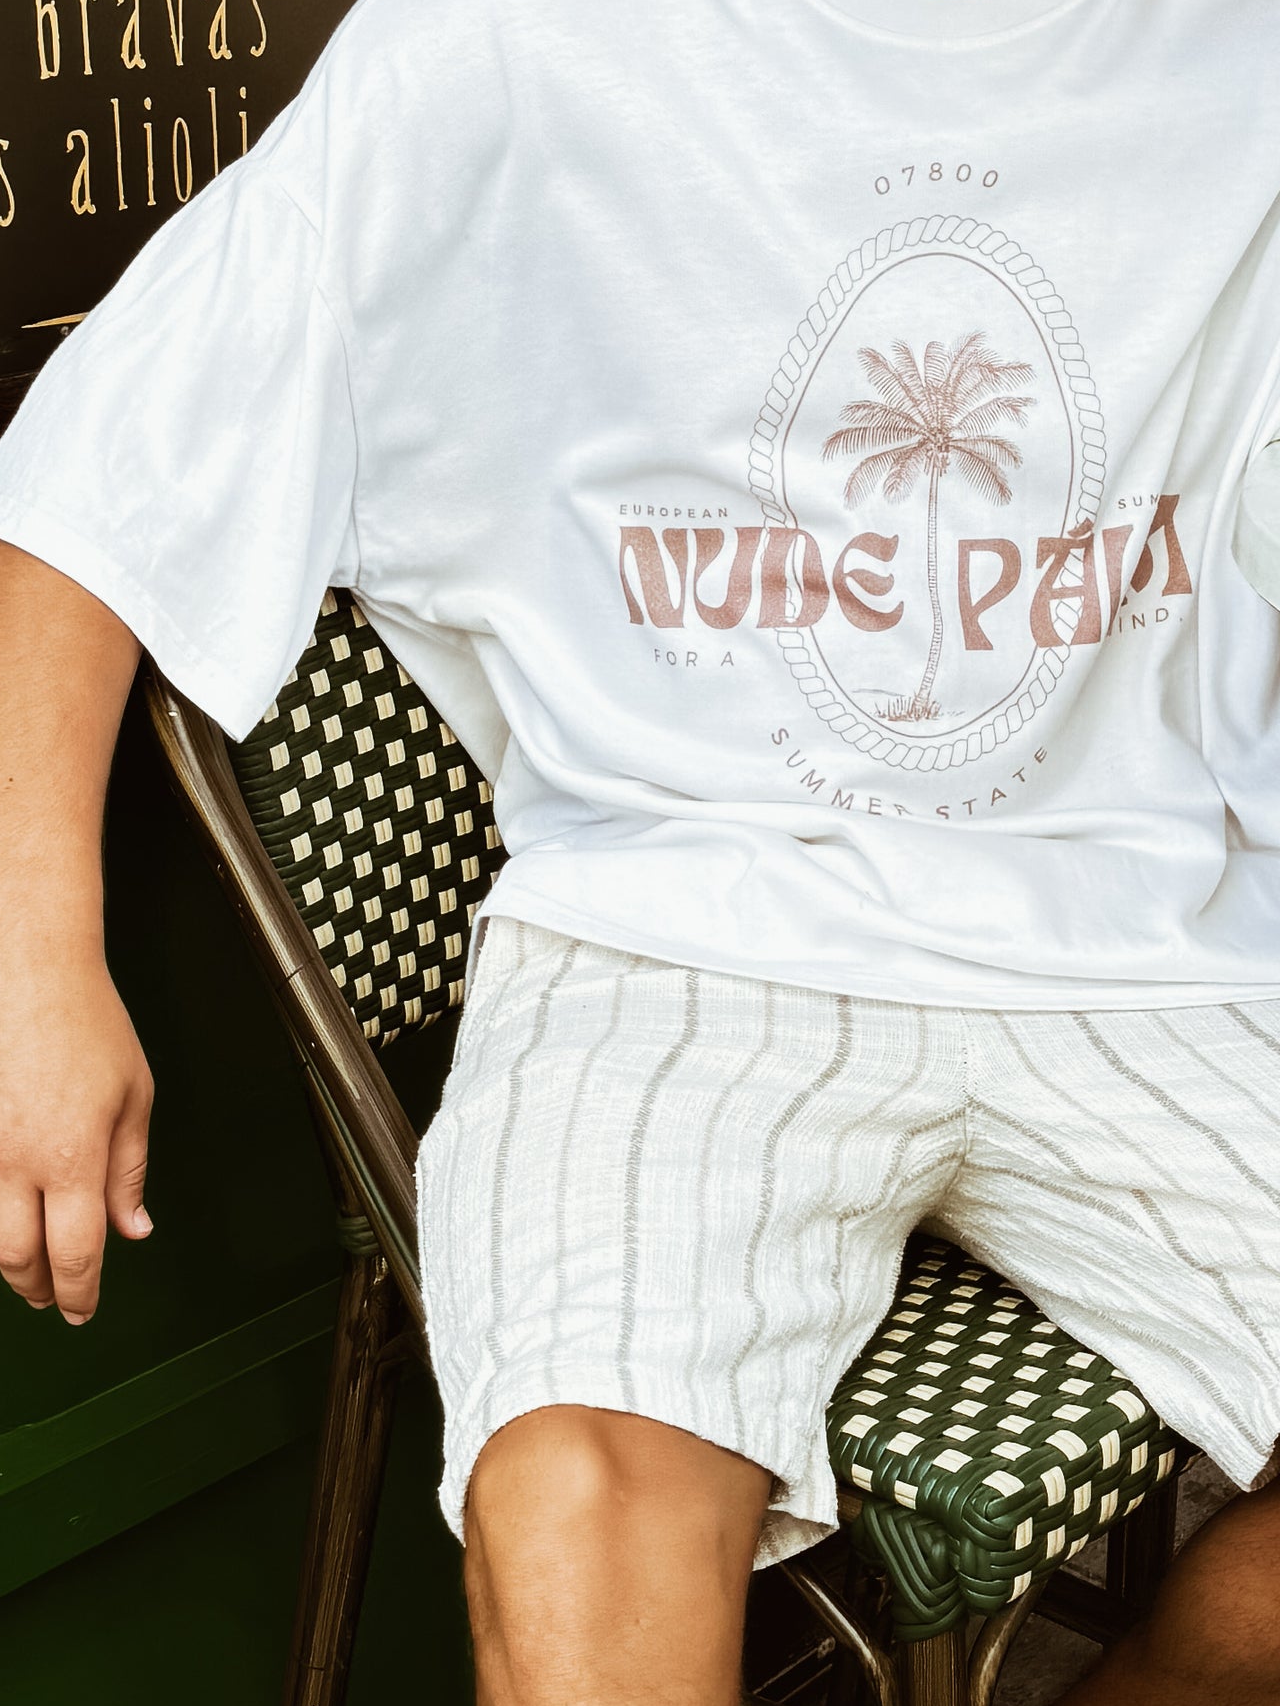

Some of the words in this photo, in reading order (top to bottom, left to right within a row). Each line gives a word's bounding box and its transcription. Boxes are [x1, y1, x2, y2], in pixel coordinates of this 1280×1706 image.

[873, 160, 1001, 196] 07800
[619, 503, 730, 519] EUROPEAN
[619, 526, 905, 633] NUDE
[654, 647, 698, 668] FOR
[720, 650, 735, 667] A
[770, 727, 914, 817] SUMMER
[936, 745, 1048, 820] STATE
